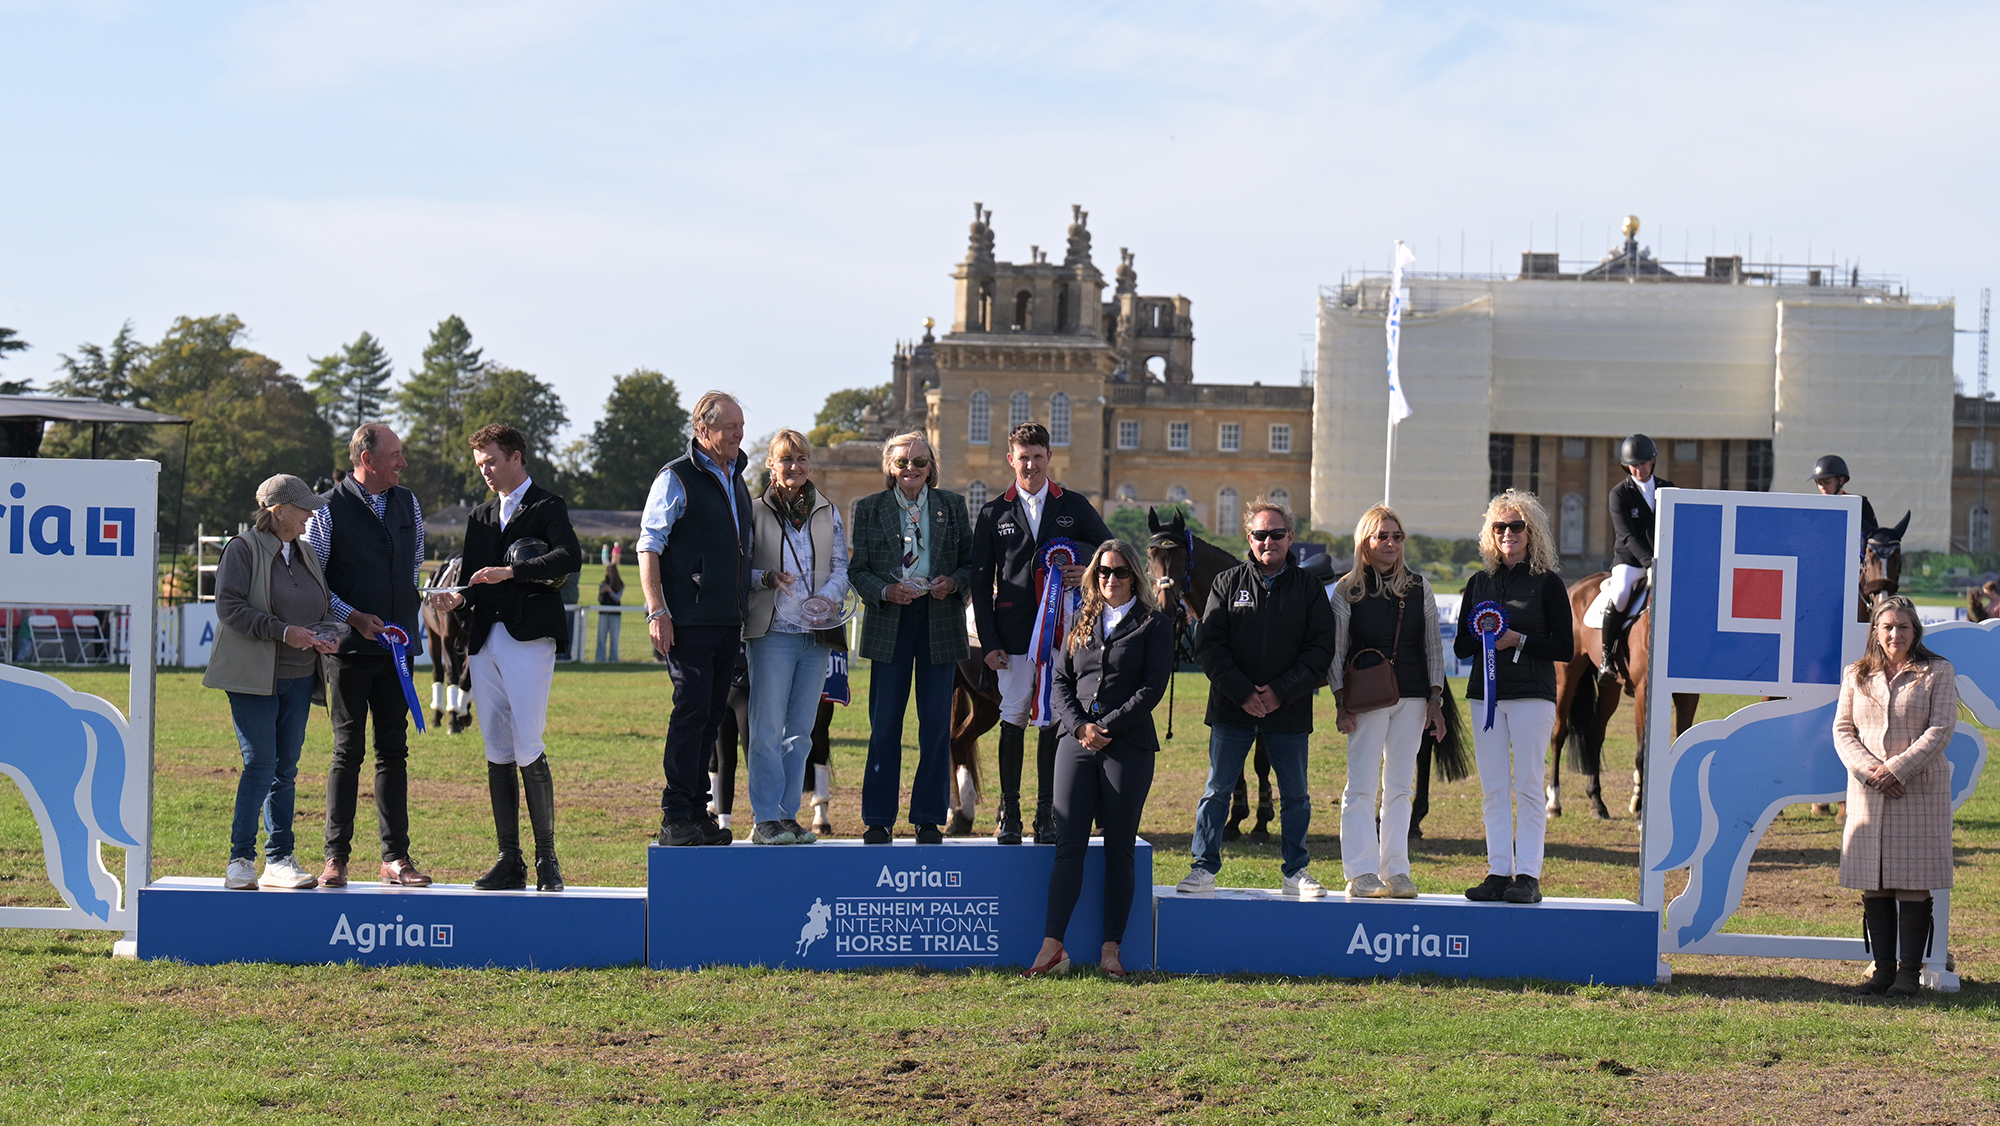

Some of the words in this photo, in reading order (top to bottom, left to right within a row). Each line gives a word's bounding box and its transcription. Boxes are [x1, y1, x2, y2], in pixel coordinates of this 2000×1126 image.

[0, 482, 75, 556] ia
[997, 528, 1015, 537] YETI
[1047, 583, 1058, 614] WINNER
[1239, 590, 1250, 602] B
[399, 655, 410, 677] THIRD
[1487, 649, 1496, 681] SECOND
[876, 865, 942, 893] Agria
[835, 903, 925, 916] BLENHEIM
[930, 902, 999, 916] PALACE
[329, 913, 426, 953] Agria
[836, 917, 999, 933] INTERNATIONAL
[836, 935, 912, 952] HORSE
[920, 934, 999, 952] TRIALS
[1346, 922, 1441, 963] Agria
